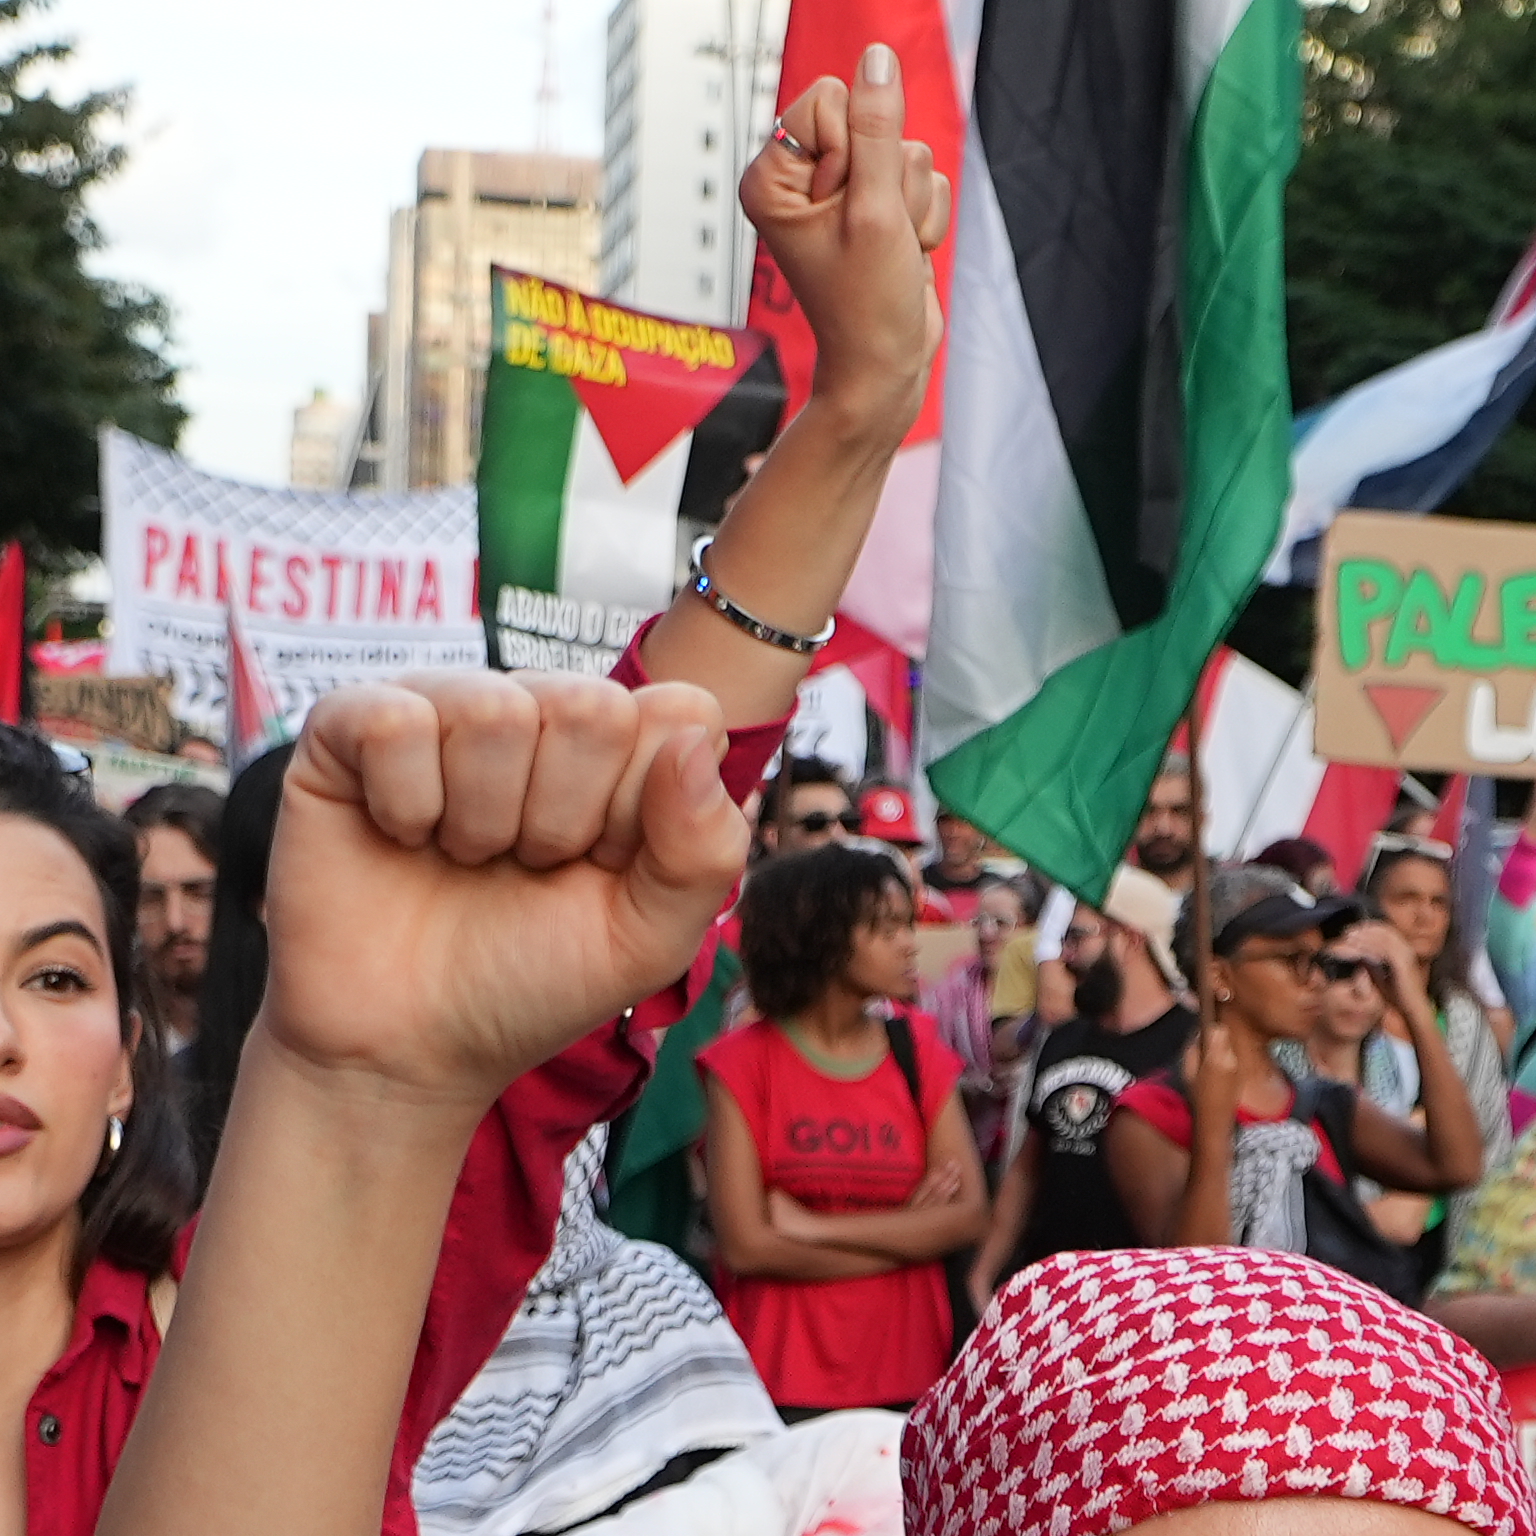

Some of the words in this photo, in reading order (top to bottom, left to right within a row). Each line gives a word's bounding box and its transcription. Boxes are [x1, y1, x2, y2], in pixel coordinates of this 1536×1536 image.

[503, 277, 565, 329] NÃO
[588, 303, 736, 373] OCUPAÇÃO
[505, 321, 548, 371] DE
[549, 330, 628, 388] GAZA
[141, 522, 444, 625] PALESTINA
[497, 583, 580, 643] ABAIXO
[581, 603, 607, 647] O
